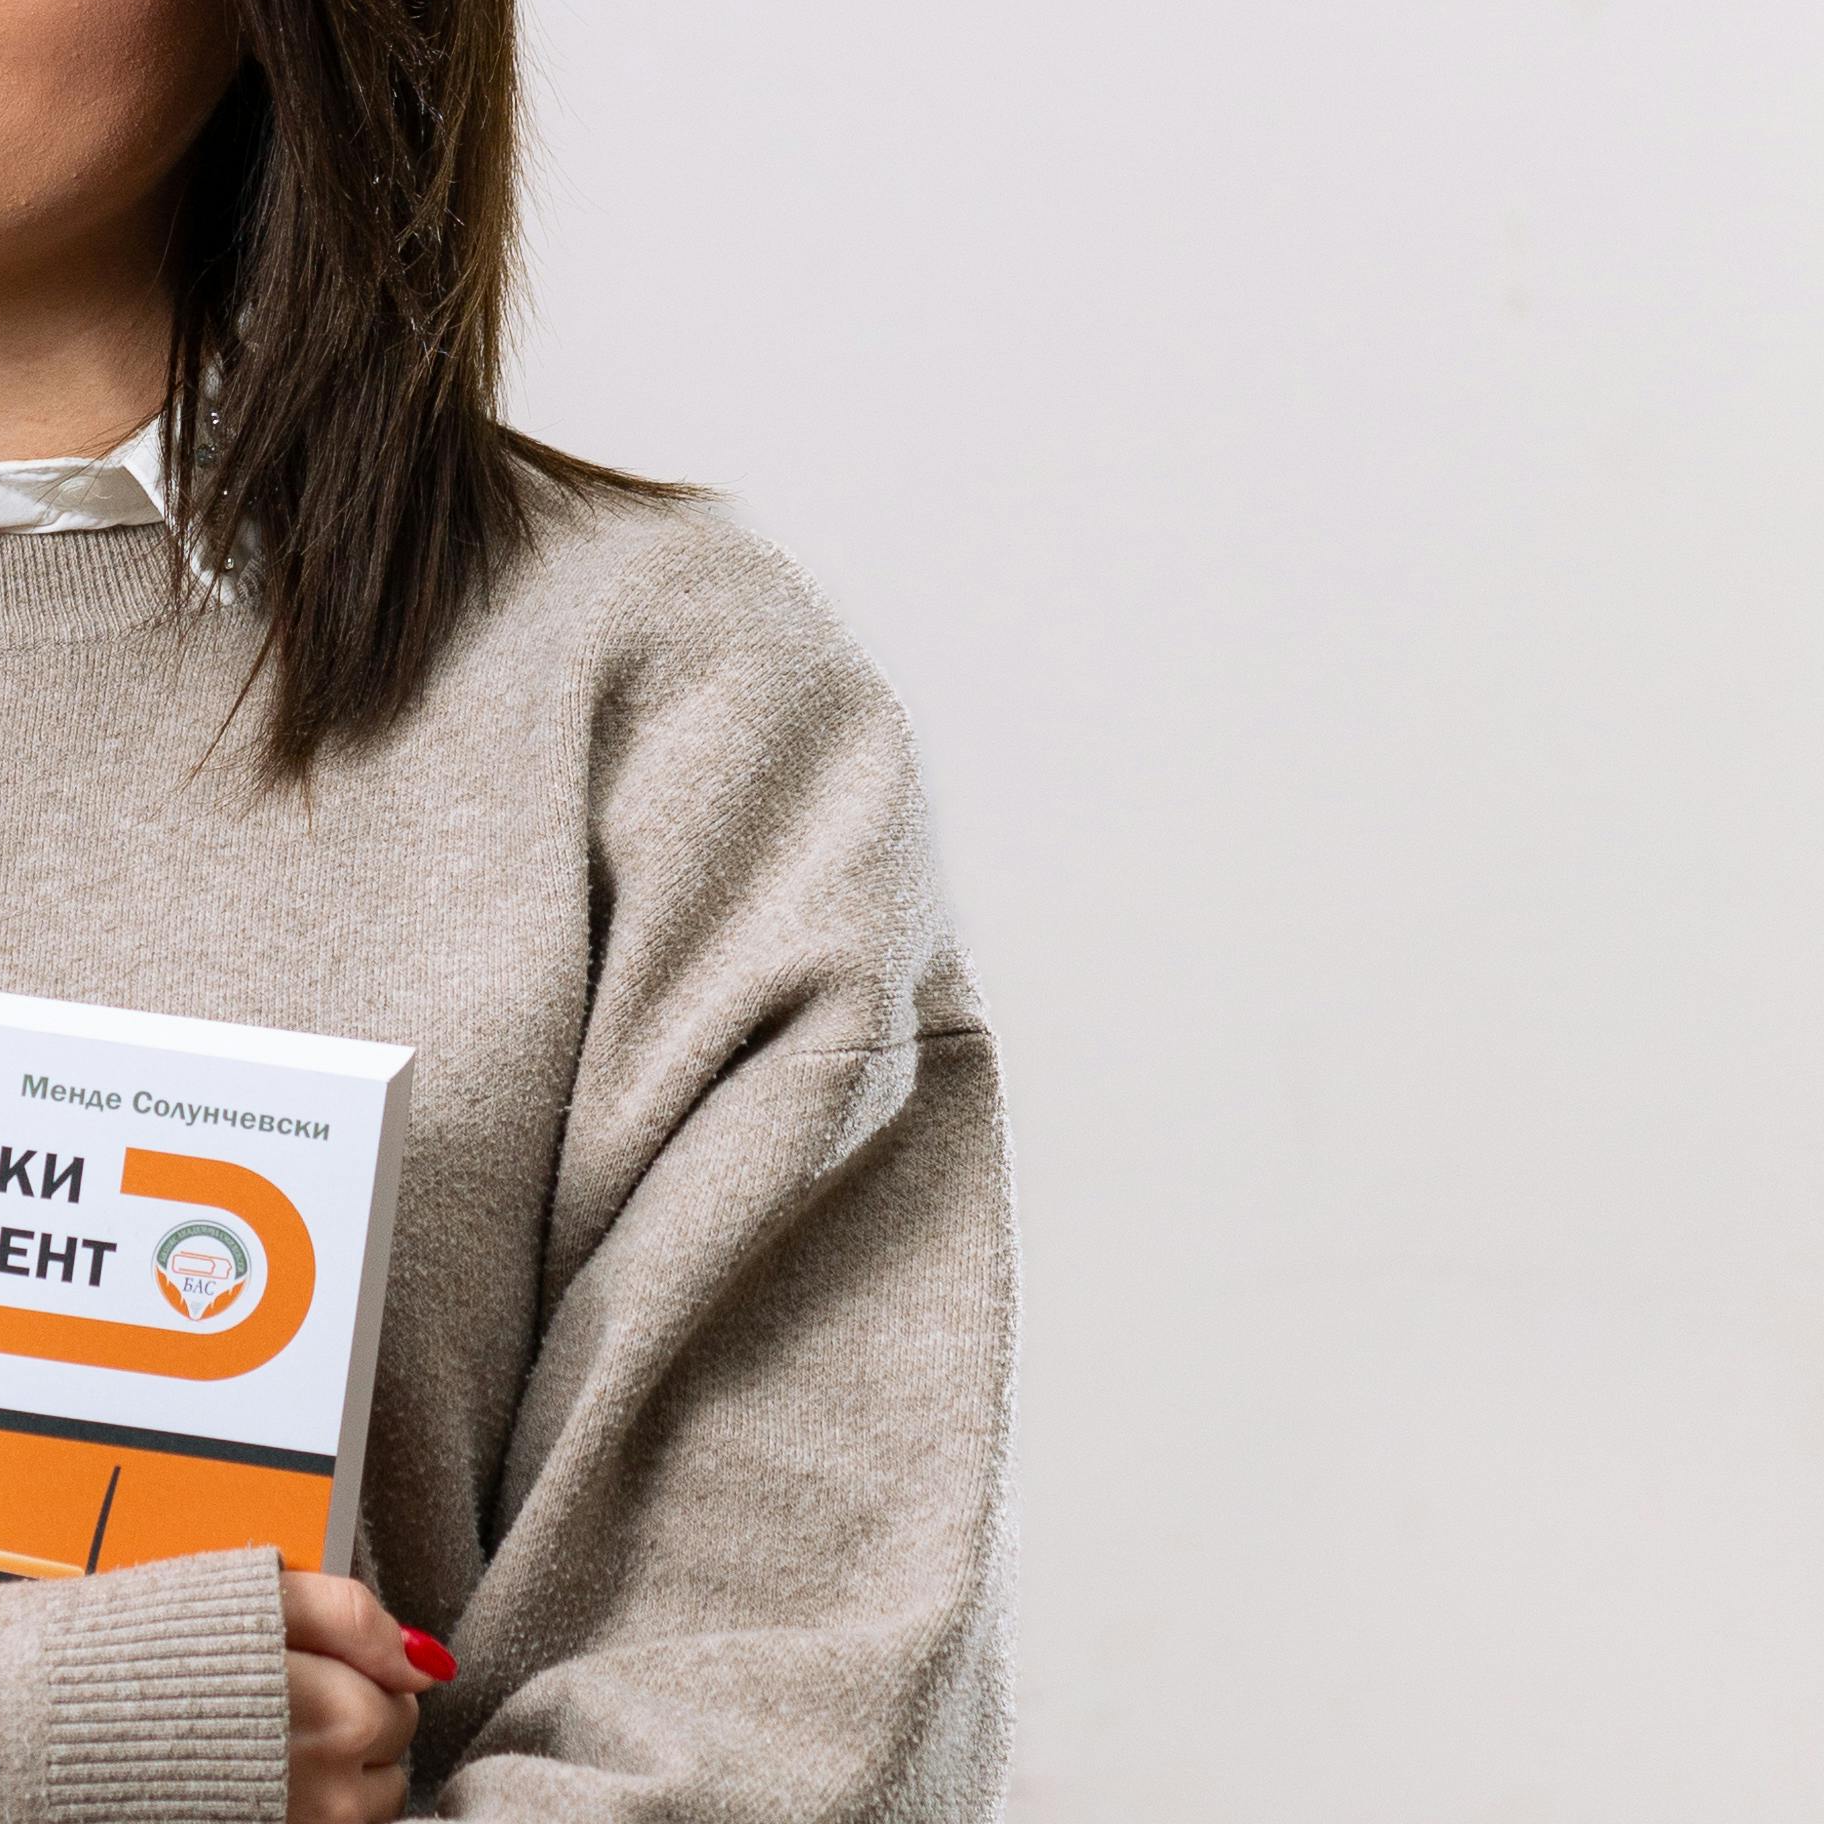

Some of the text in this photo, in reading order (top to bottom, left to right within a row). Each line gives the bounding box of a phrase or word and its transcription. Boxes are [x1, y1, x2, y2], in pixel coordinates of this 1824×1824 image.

[21, 1073, 330, 1141] Менде Солунчевски
[182, 1277, 217, 1296] БАС
